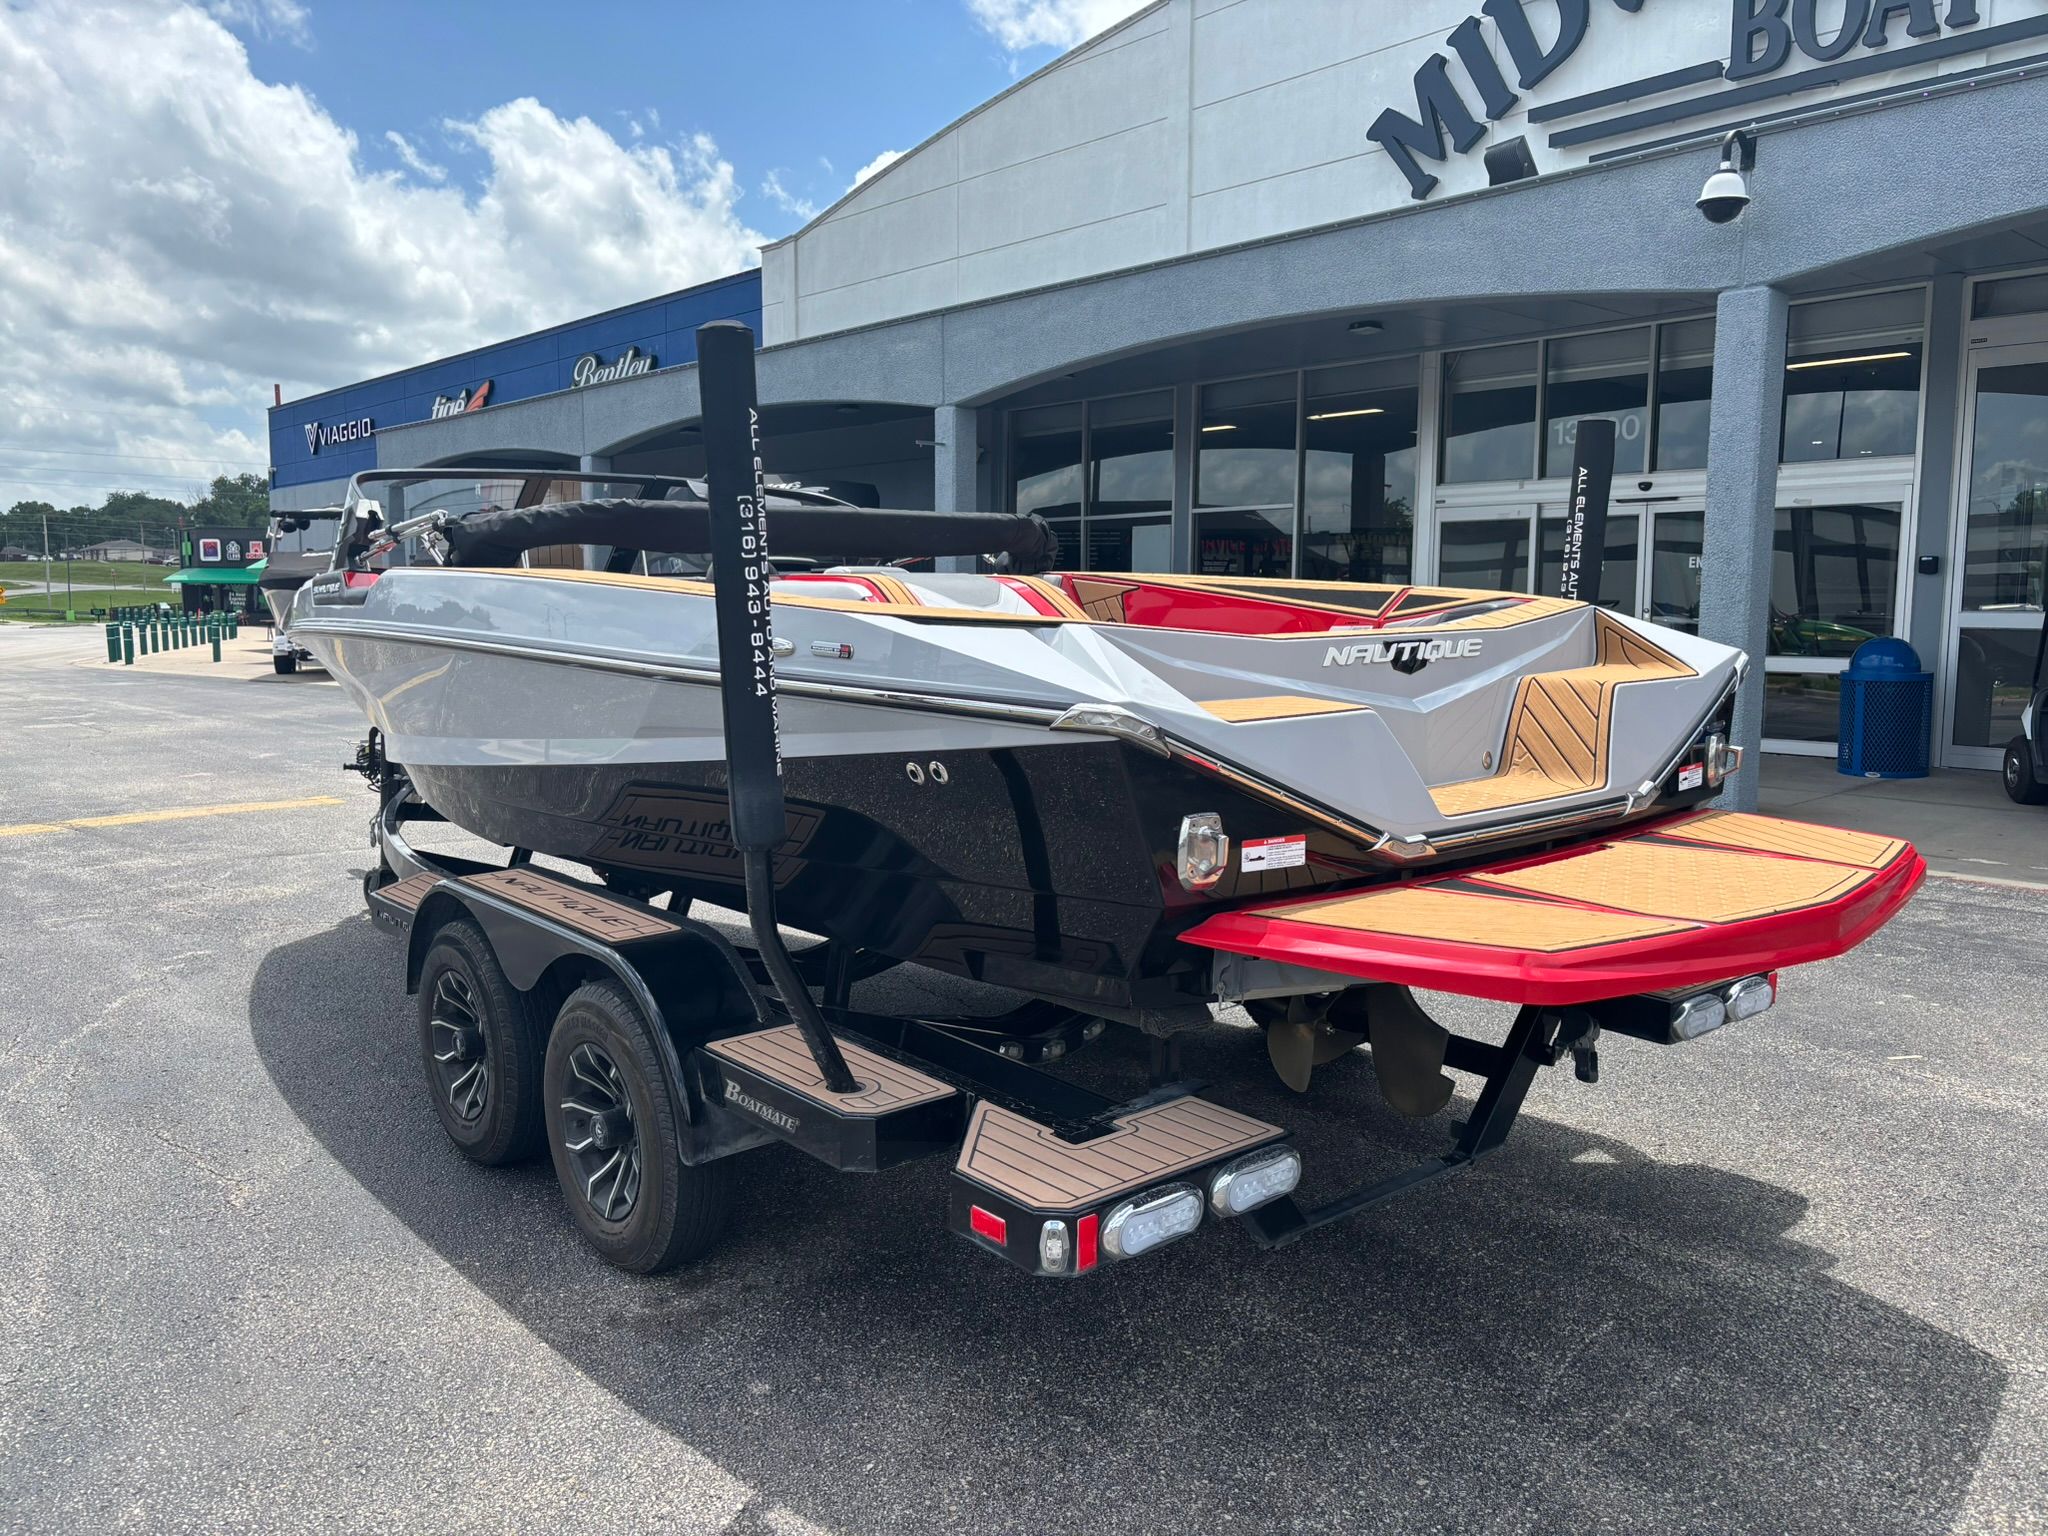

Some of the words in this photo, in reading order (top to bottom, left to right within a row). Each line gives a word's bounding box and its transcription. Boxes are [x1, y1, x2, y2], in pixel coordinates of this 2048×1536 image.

[1366, 0, 1644, 199] MID
[572, 350, 652, 388] Bentley
[318, 417, 371, 446] VIAGGIO
[749, 408, 760, 451] ALL
[1578, 466, 1588, 494] ALL
[737, 495, 757, 559] (316)
[754, 456, 769, 574] ELEMENTS
[1570, 496, 1586, 569] ELEMENTS
[1567, 571, 1579, 600] AUT
[745, 566, 769, 697] 943-8444
[1322, 638, 1483, 668] NAUTIQUE
[498, 876, 639, 928] NAUTIQUE
